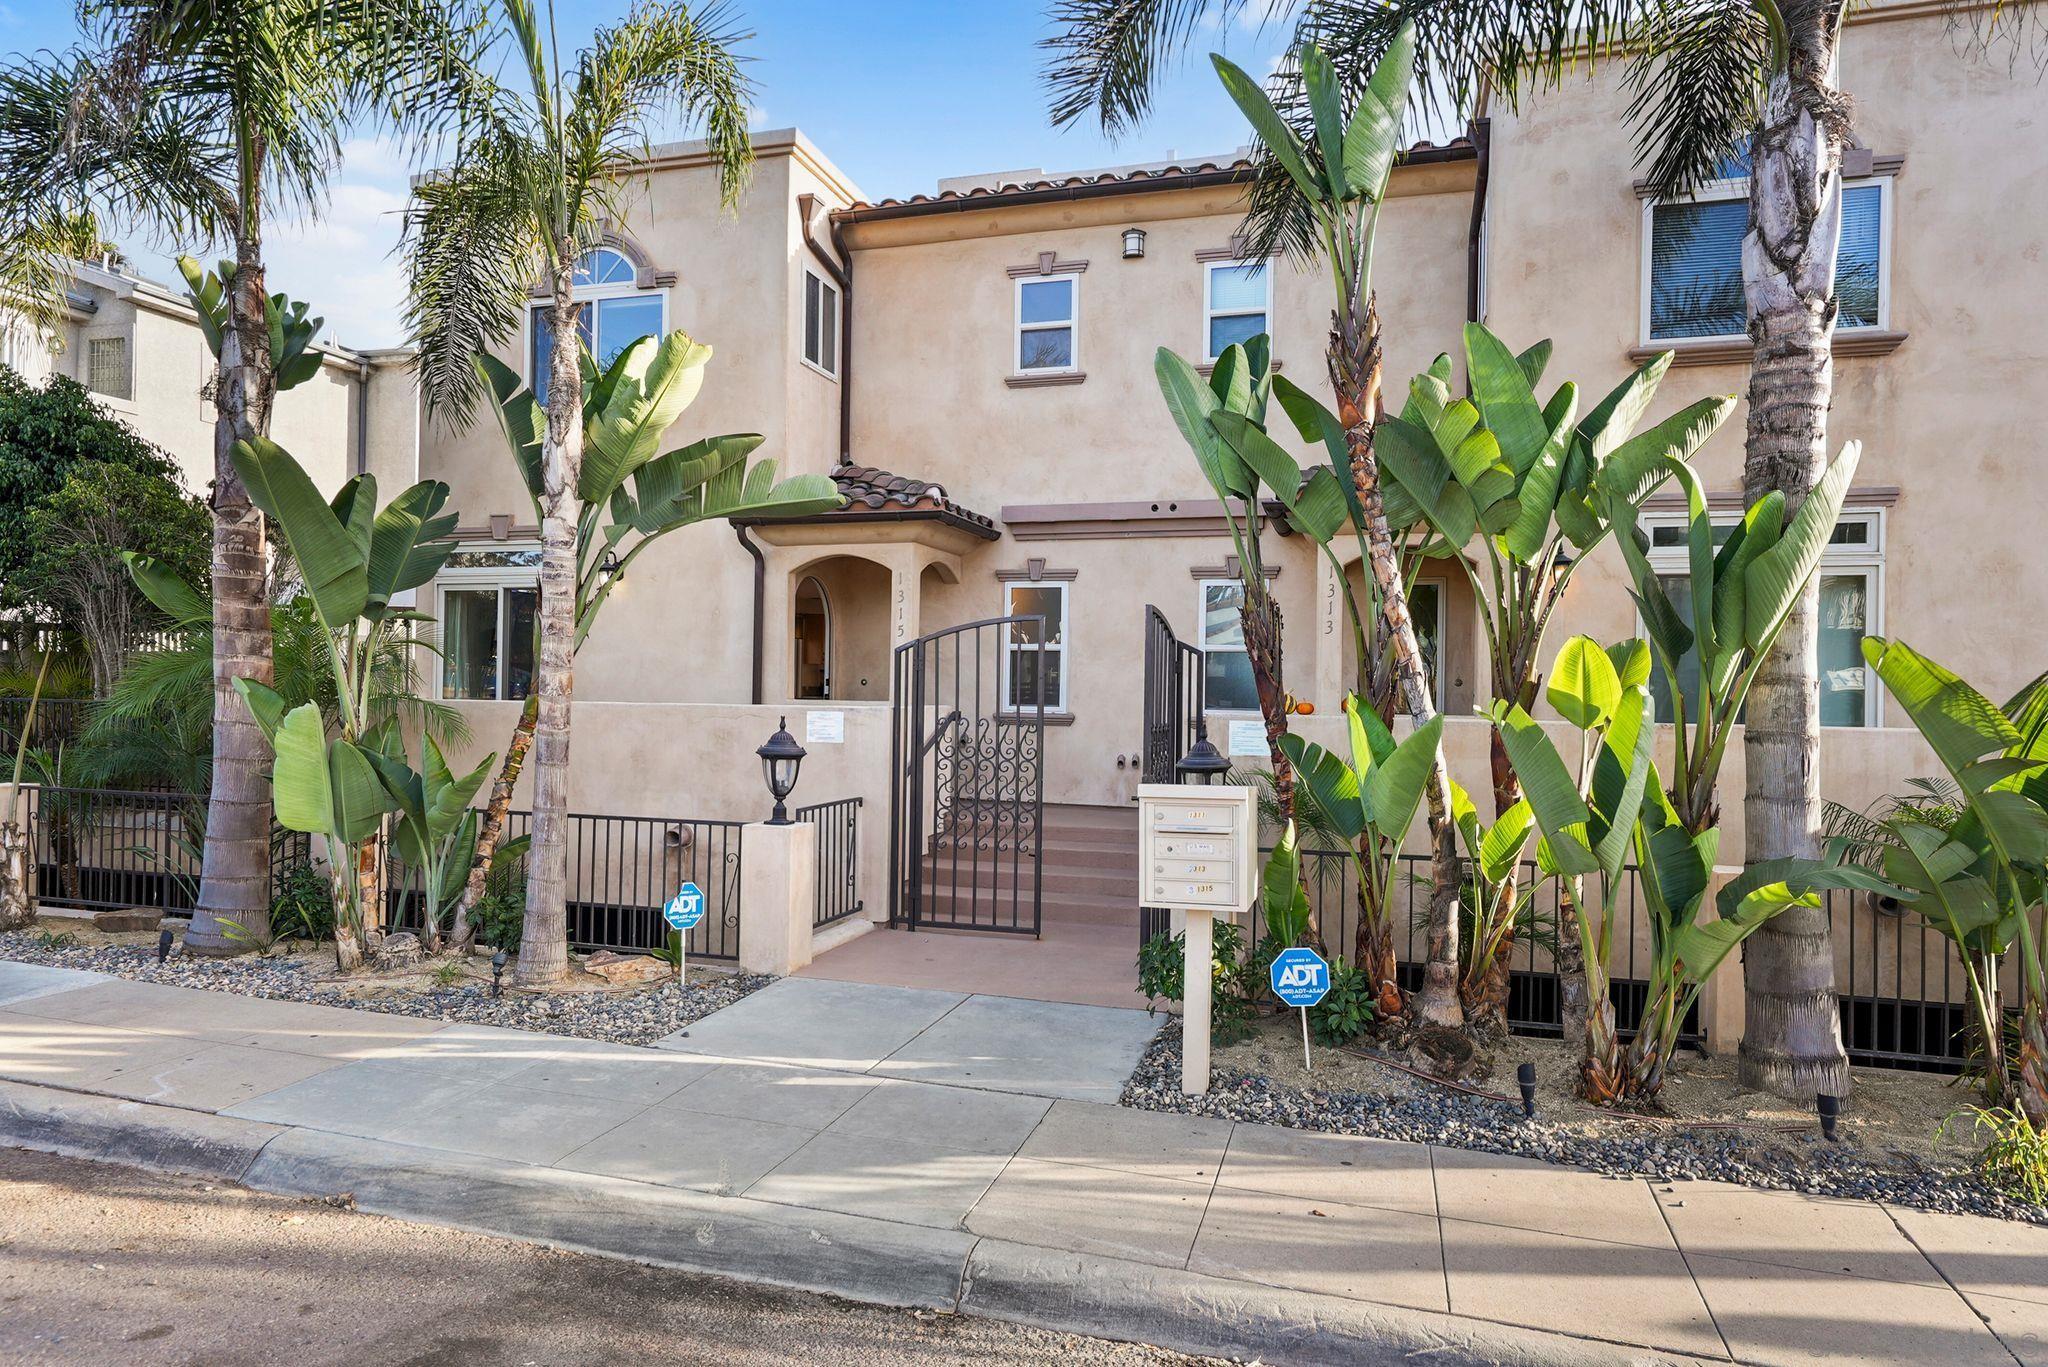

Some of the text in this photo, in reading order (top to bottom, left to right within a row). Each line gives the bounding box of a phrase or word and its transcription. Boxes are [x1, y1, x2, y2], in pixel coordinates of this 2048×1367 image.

[897, 572, 905, 637] 1315
[1324, 565, 1335, 635] 1313
[668, 895, 700, 914] ADT
[1278, 964, 1322, 987] ADT
